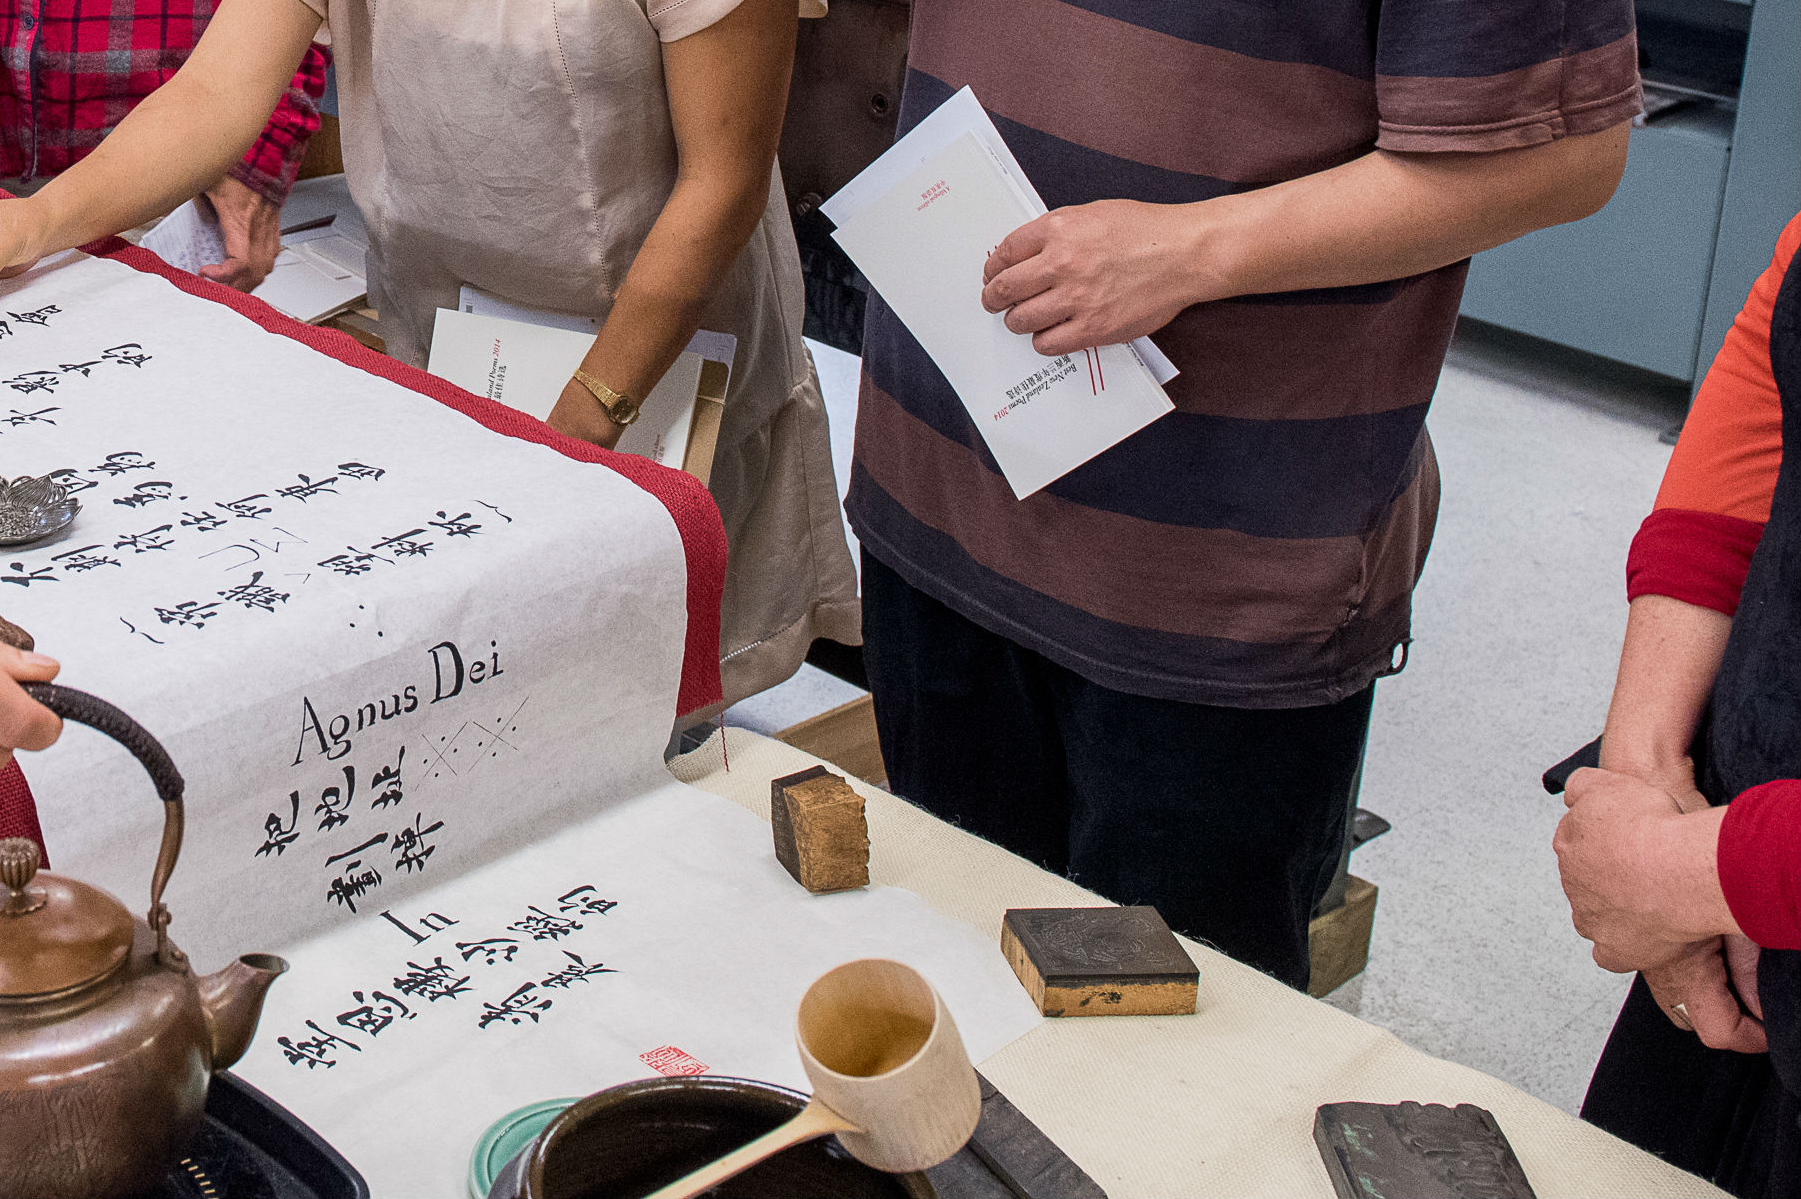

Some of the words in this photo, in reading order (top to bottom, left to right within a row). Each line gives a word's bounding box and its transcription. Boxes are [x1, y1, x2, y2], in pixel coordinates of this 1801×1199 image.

[492, 338, 501, 358] 2014
[488, 357, 498, 379] Poems
[1049, 371, 1065, 384] New
[1064, 363, 1078, 375] Best
[1025, 381, 1051, 402] Zealand
[1008, 395, 1027, 410] Poems
[993, 406, 1009, 422] 2014
[291, 684, 419, 766] Agnus
[428, 639, 505, 704] Dei
[379, 908, 460, 947] In
